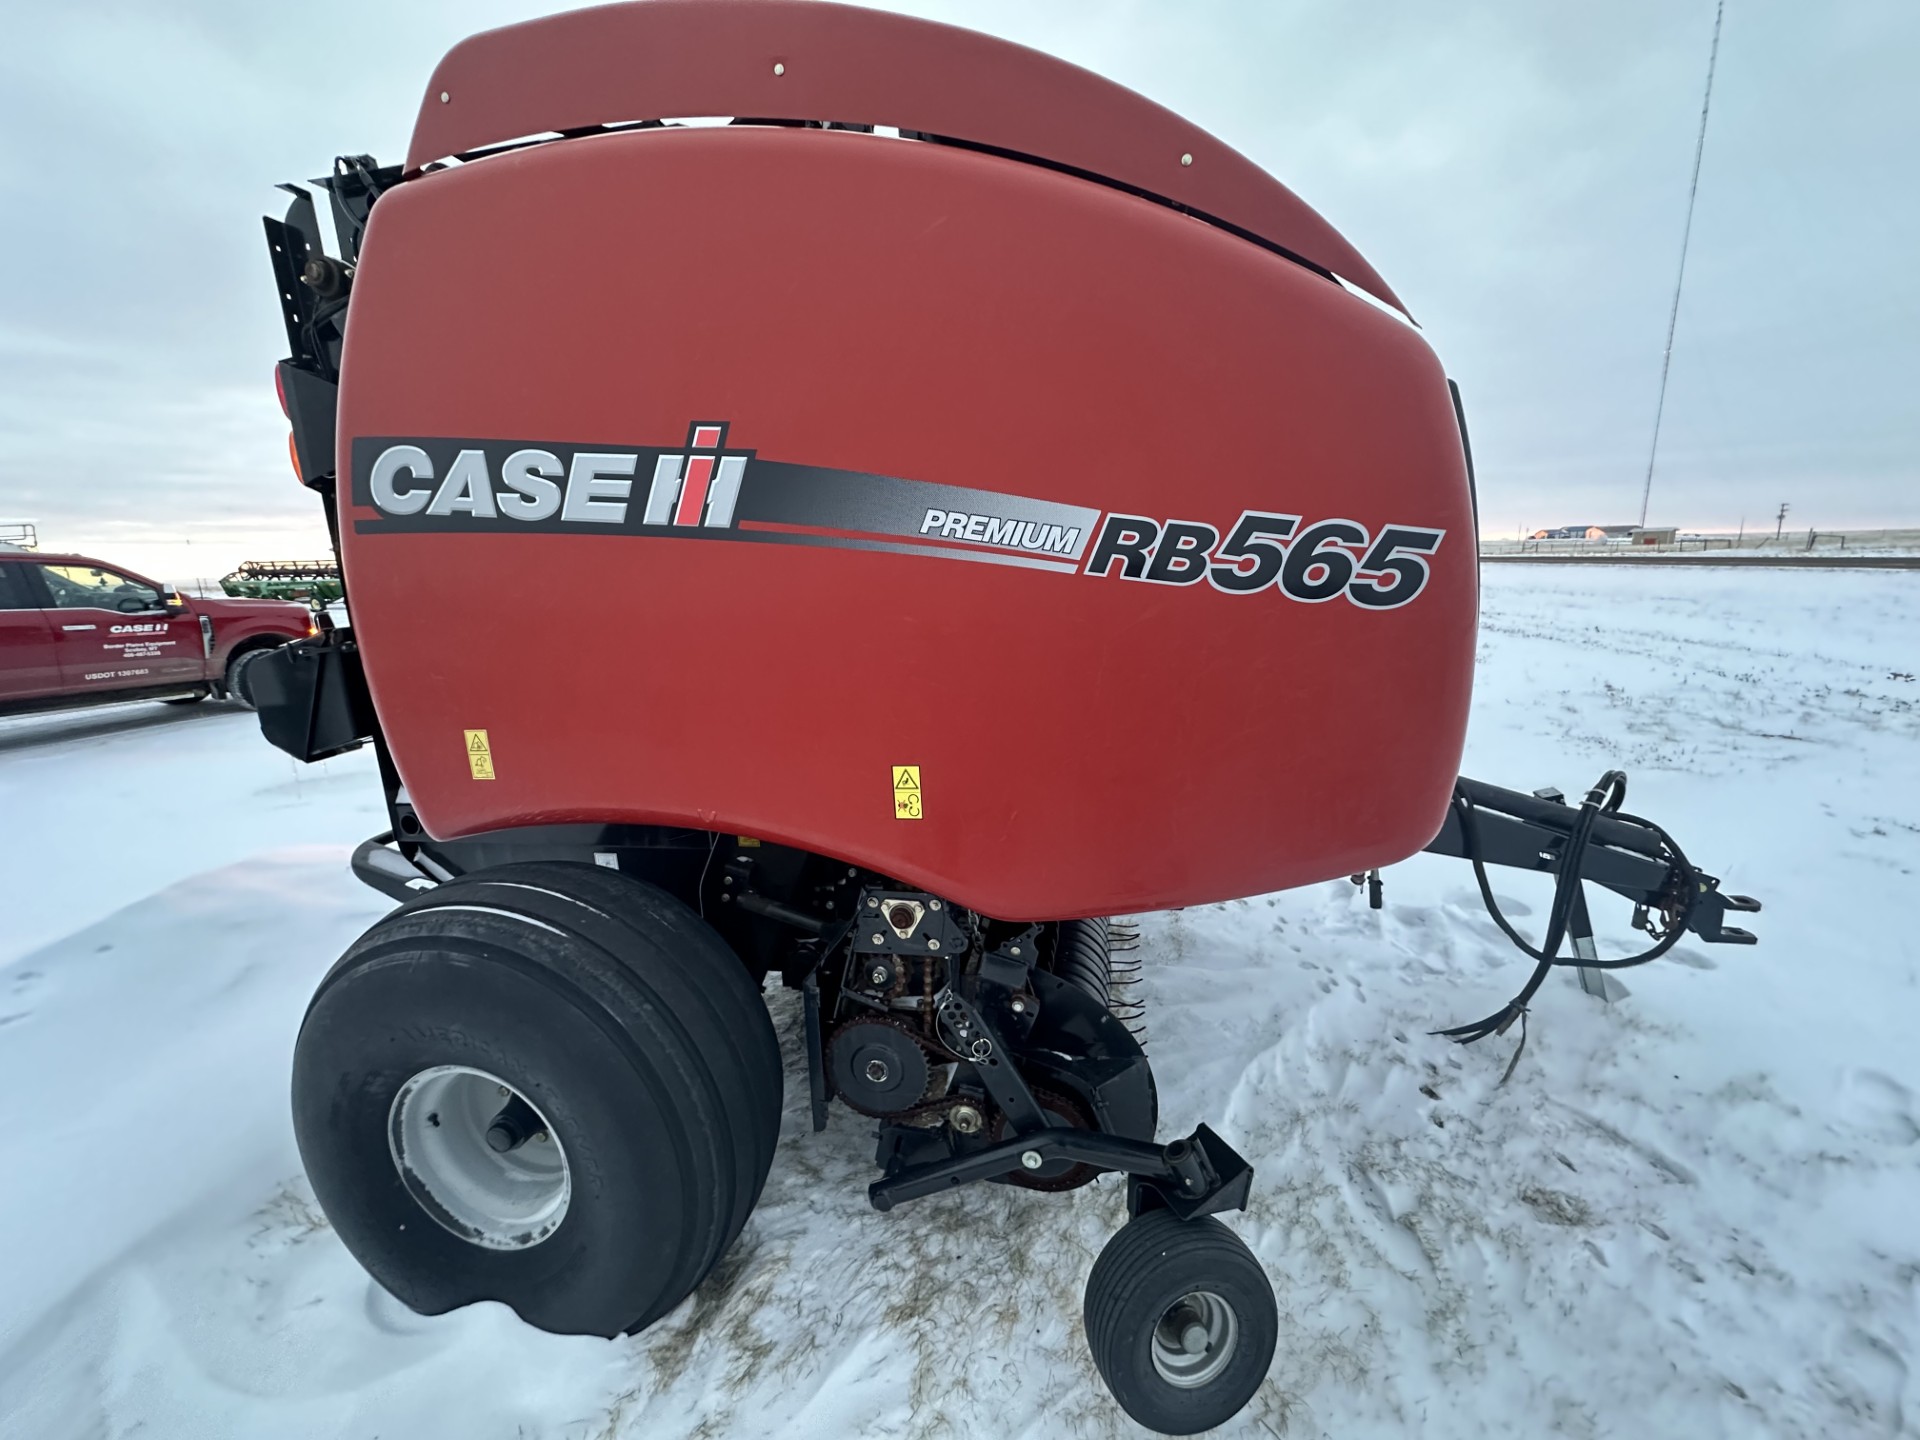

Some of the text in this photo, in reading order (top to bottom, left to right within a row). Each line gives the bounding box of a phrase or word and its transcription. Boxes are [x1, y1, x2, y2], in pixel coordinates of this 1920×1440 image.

[369, 445, 638, 523] CASE
[919, 508, 1447, 611] PREMIUM RB565
[110, 624, 154, 633] CASE
[85, 671, 116, 680] USDOT
